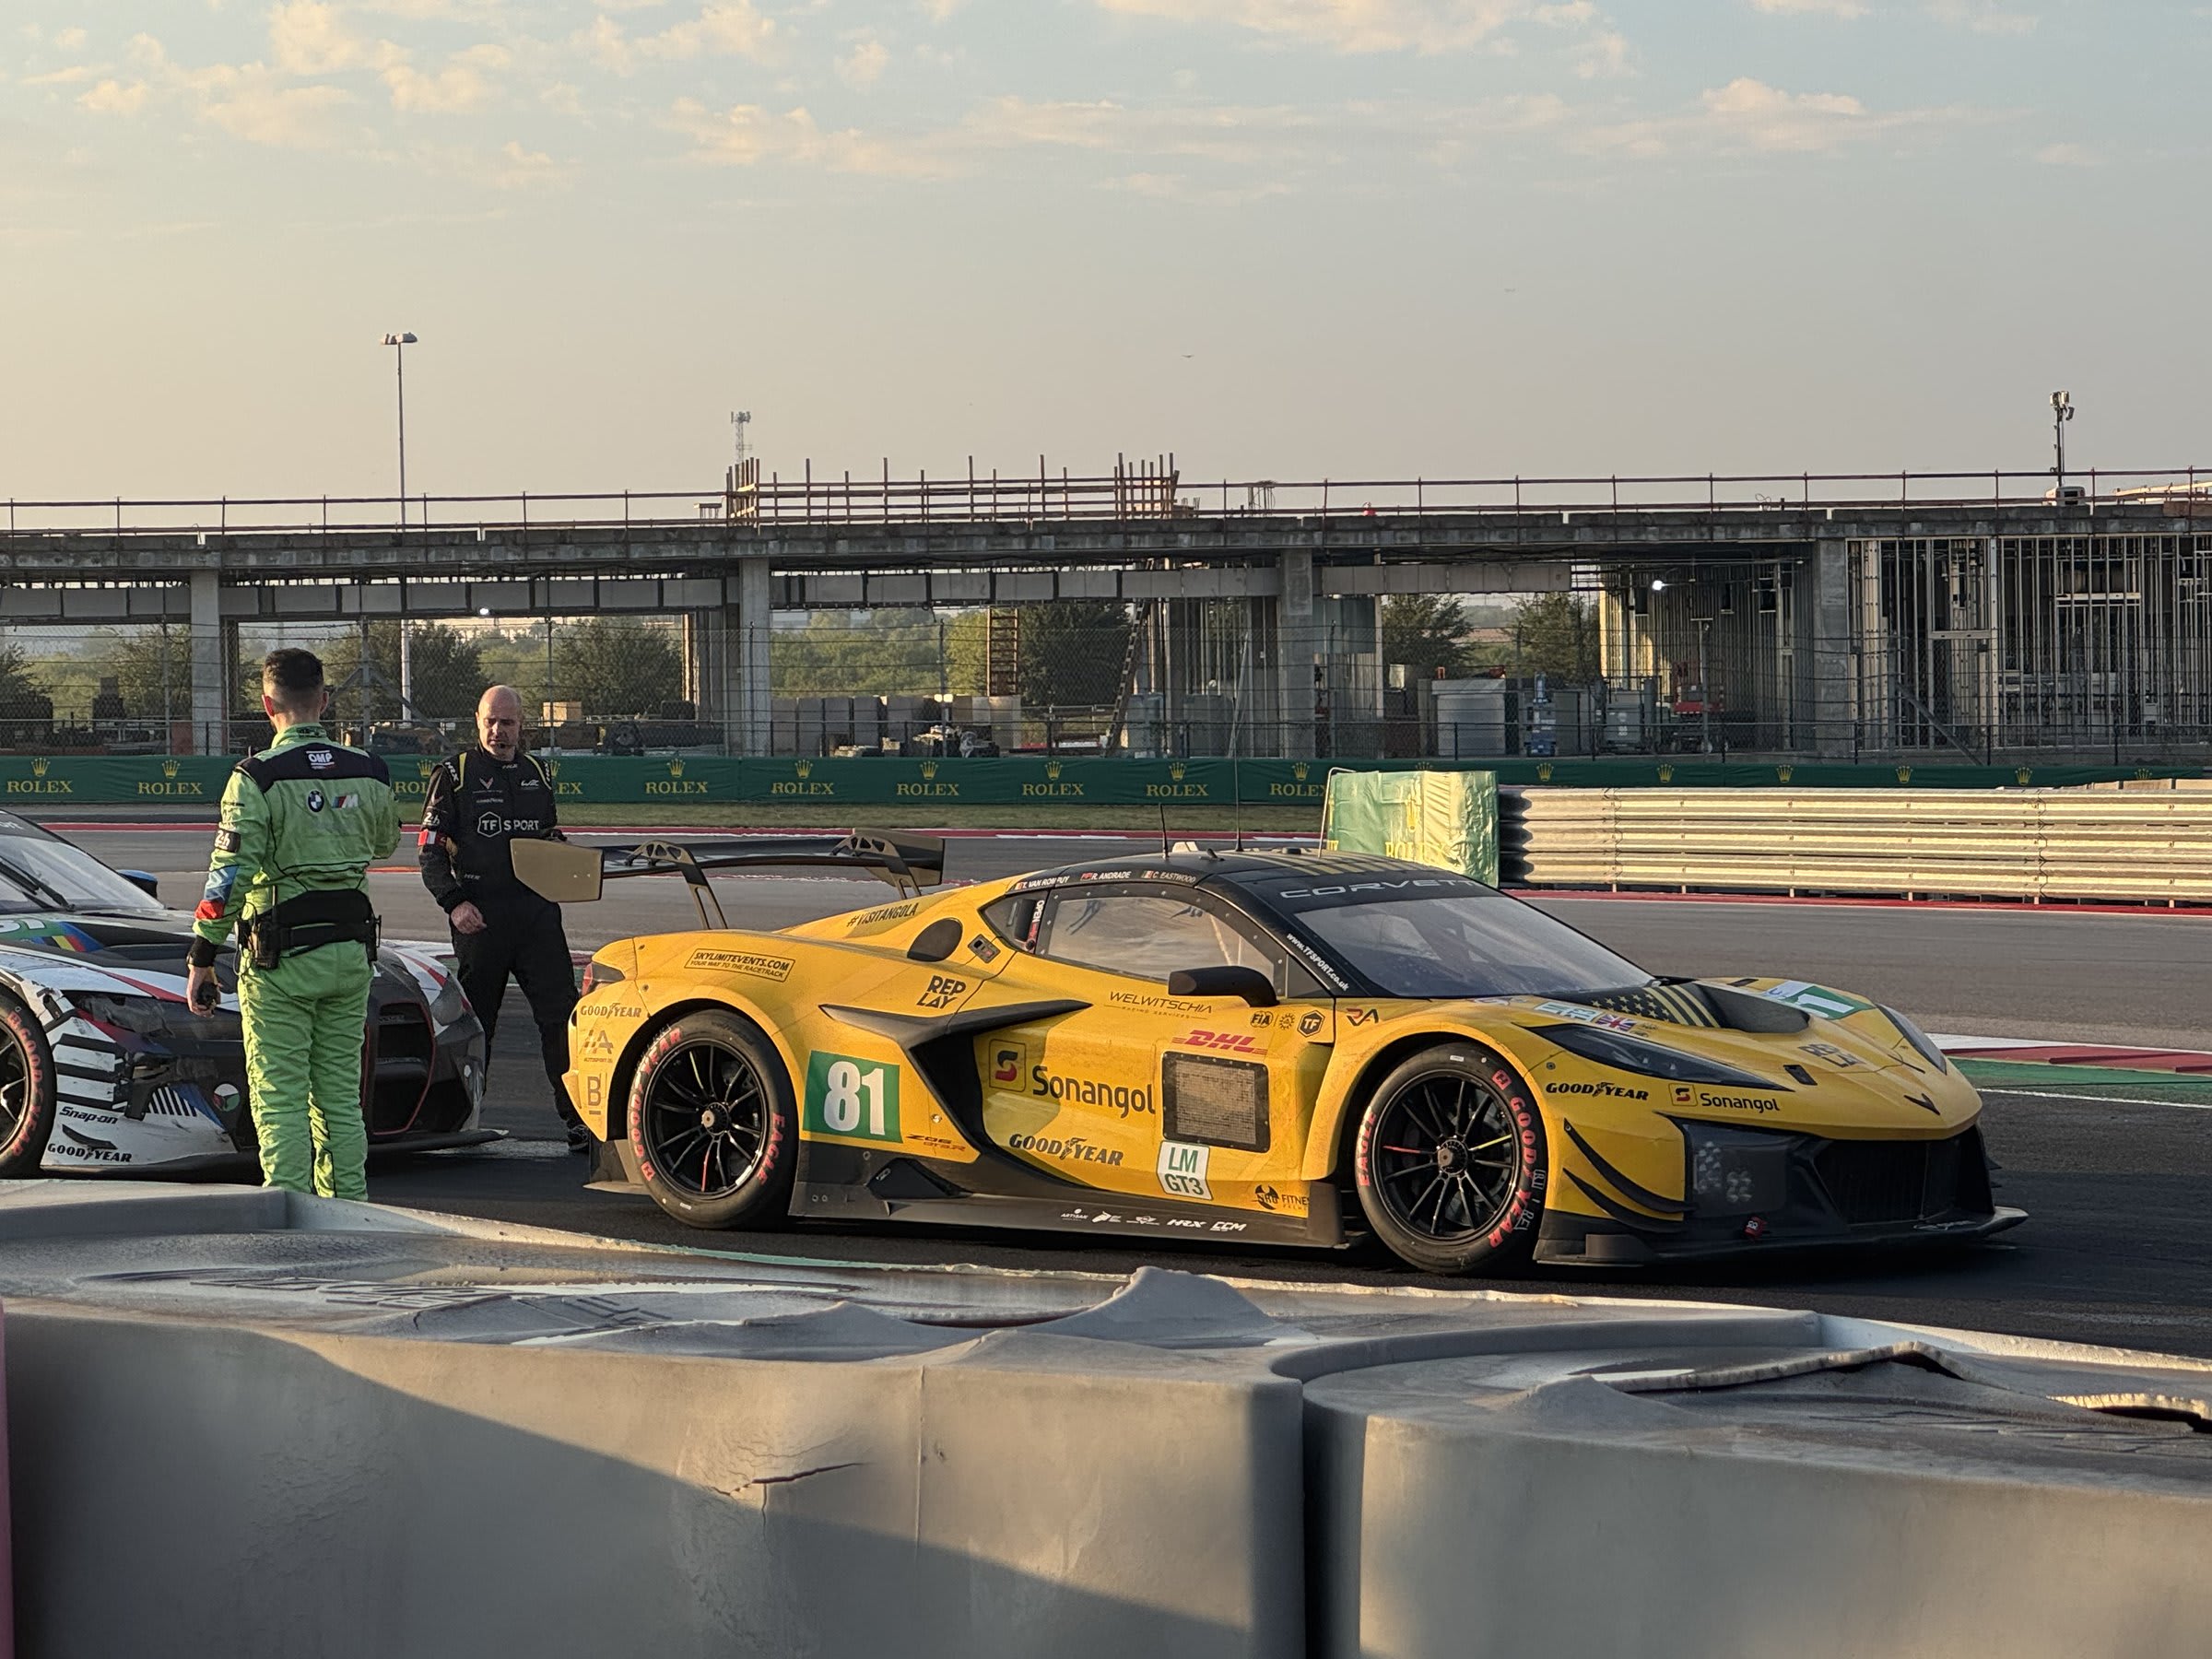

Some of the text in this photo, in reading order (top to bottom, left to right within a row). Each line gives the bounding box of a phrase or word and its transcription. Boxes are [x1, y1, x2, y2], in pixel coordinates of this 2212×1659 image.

[308, 753, 333, 763] OMP
[7, 781, 73, 794] ROLEX
[138, 782, 203, 794] ROLEX
[394, 782, 427, 794] ROL
[645, 781, 708, 794] ROLEX
[771, 782, 834, 794] ROLEX
[897, 783, 959, 796] ROLEX
[1022, 783, 1084, 796] ROLEX
[1147, 784, 1208, 797] ROLEX
[482, 820, 498, 830] TF
[1099, 871, 1132, 880] ANDRADE
[1159, 872, 1196, 883] EASTWOOD
[847, 902, 920, 927] #VISITANGOLA
[693, 952, 791, 971] SKYLIMITEVENTS.COM
[1287, 933, 1349, 992] www.TFSPORT.co.uk
[927, 975, 966, 996] REP
[580, 1003, 642, 1018] GOODYEAR
[916, 993, 958, 1009] LAY
[1110, 991, 1212, 1014] WELWITSCHIA
[1252, 1013, 1271, 1025] FIA
[1183, 1029, 1257, 1054] DHL
[823, 1061, 886, 1135] 81
[1032, 1065, 1157, 1119] Sonangol
[1546, 1082, 1650, 1101] GOODYEAR
[1700, 1093, 1781, 1114] Sonangol
[59, 1106, 118, 1125] Snap-on
[48, 1143, 133, 1162] GOODYEAR
[757, 1112, 785, 1185] EAGLE
[1008, 1133, 1124, 1167] GOODYEAR
[1167, 1146, 1198, 1174] LM
[1164, 1173, 1205, 1196] GT3
